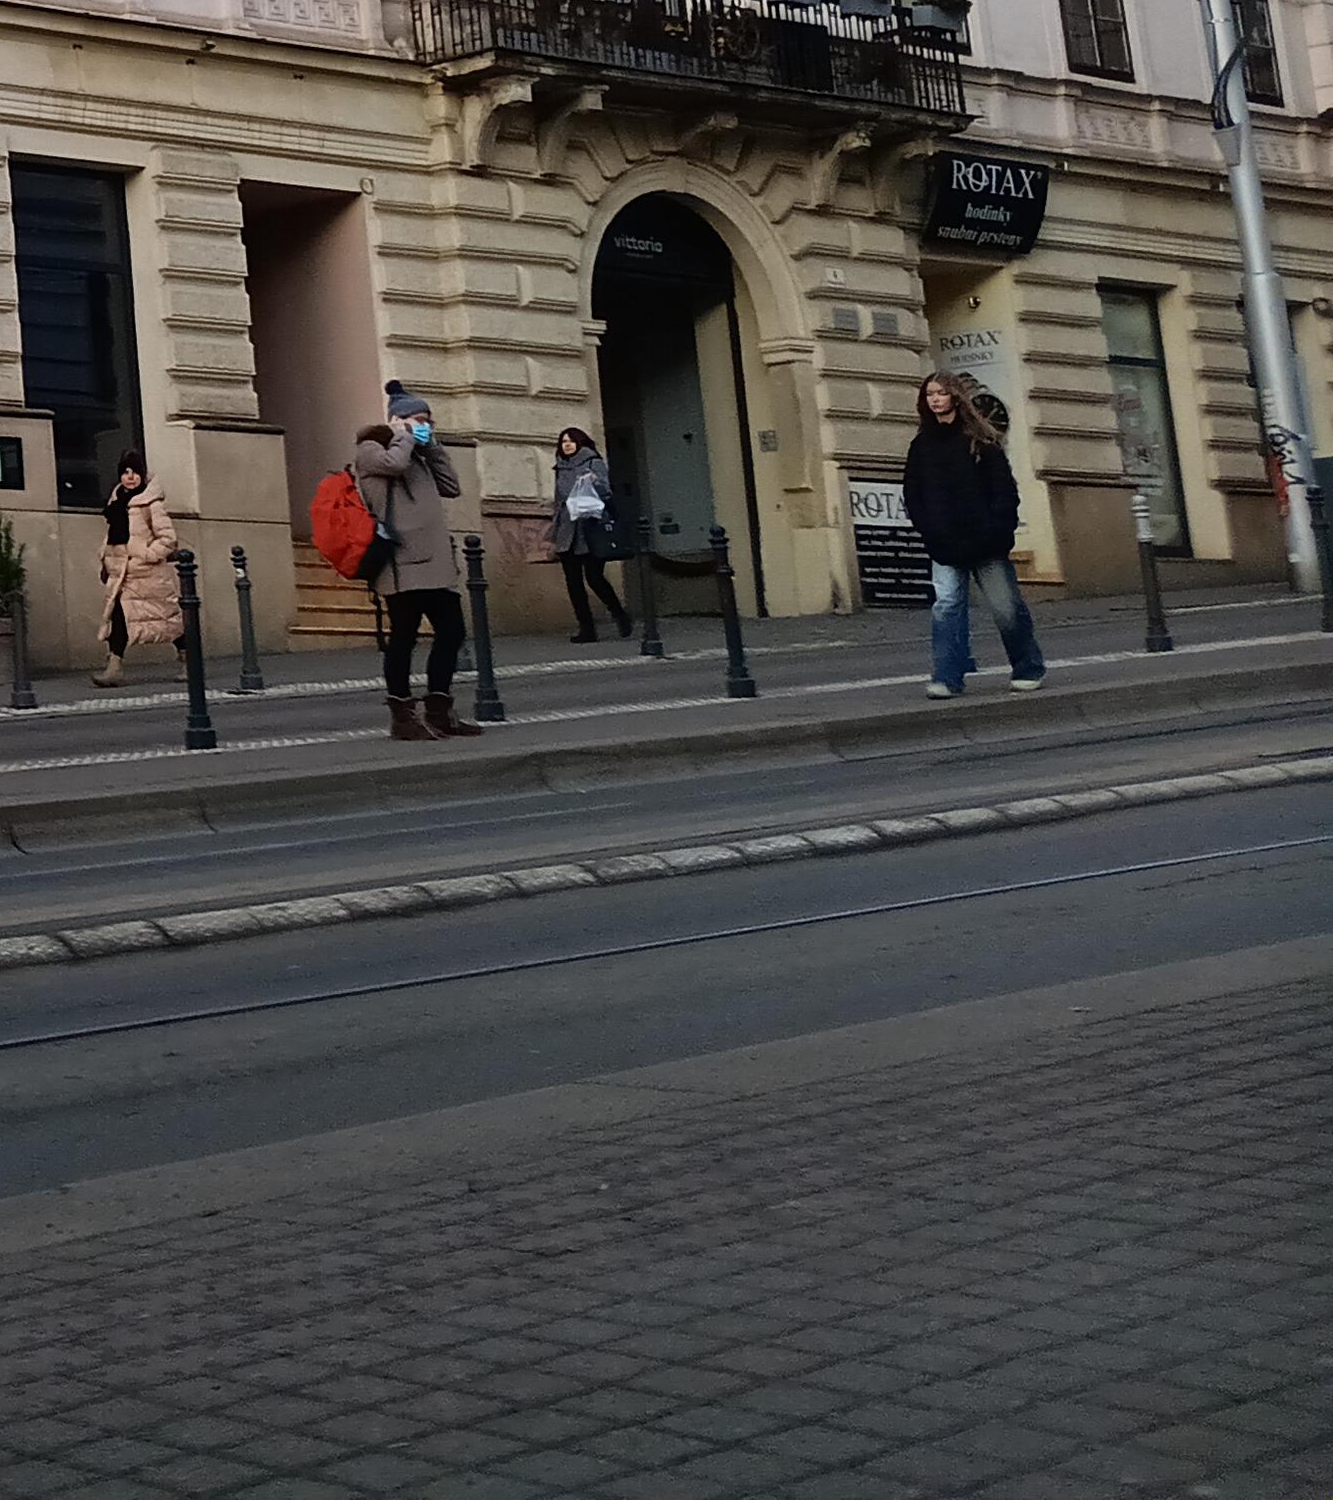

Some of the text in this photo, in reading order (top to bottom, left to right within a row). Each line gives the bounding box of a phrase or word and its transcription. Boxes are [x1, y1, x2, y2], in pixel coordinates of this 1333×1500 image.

[951, 159, 1036, 199] ROTAX
[964, 202, 1012, 227] hodinky
[613, 234, 663, 253] vittorio
[939, 330, 999, 352] ROTAX
[849, 490, 910, 520] ROTA
